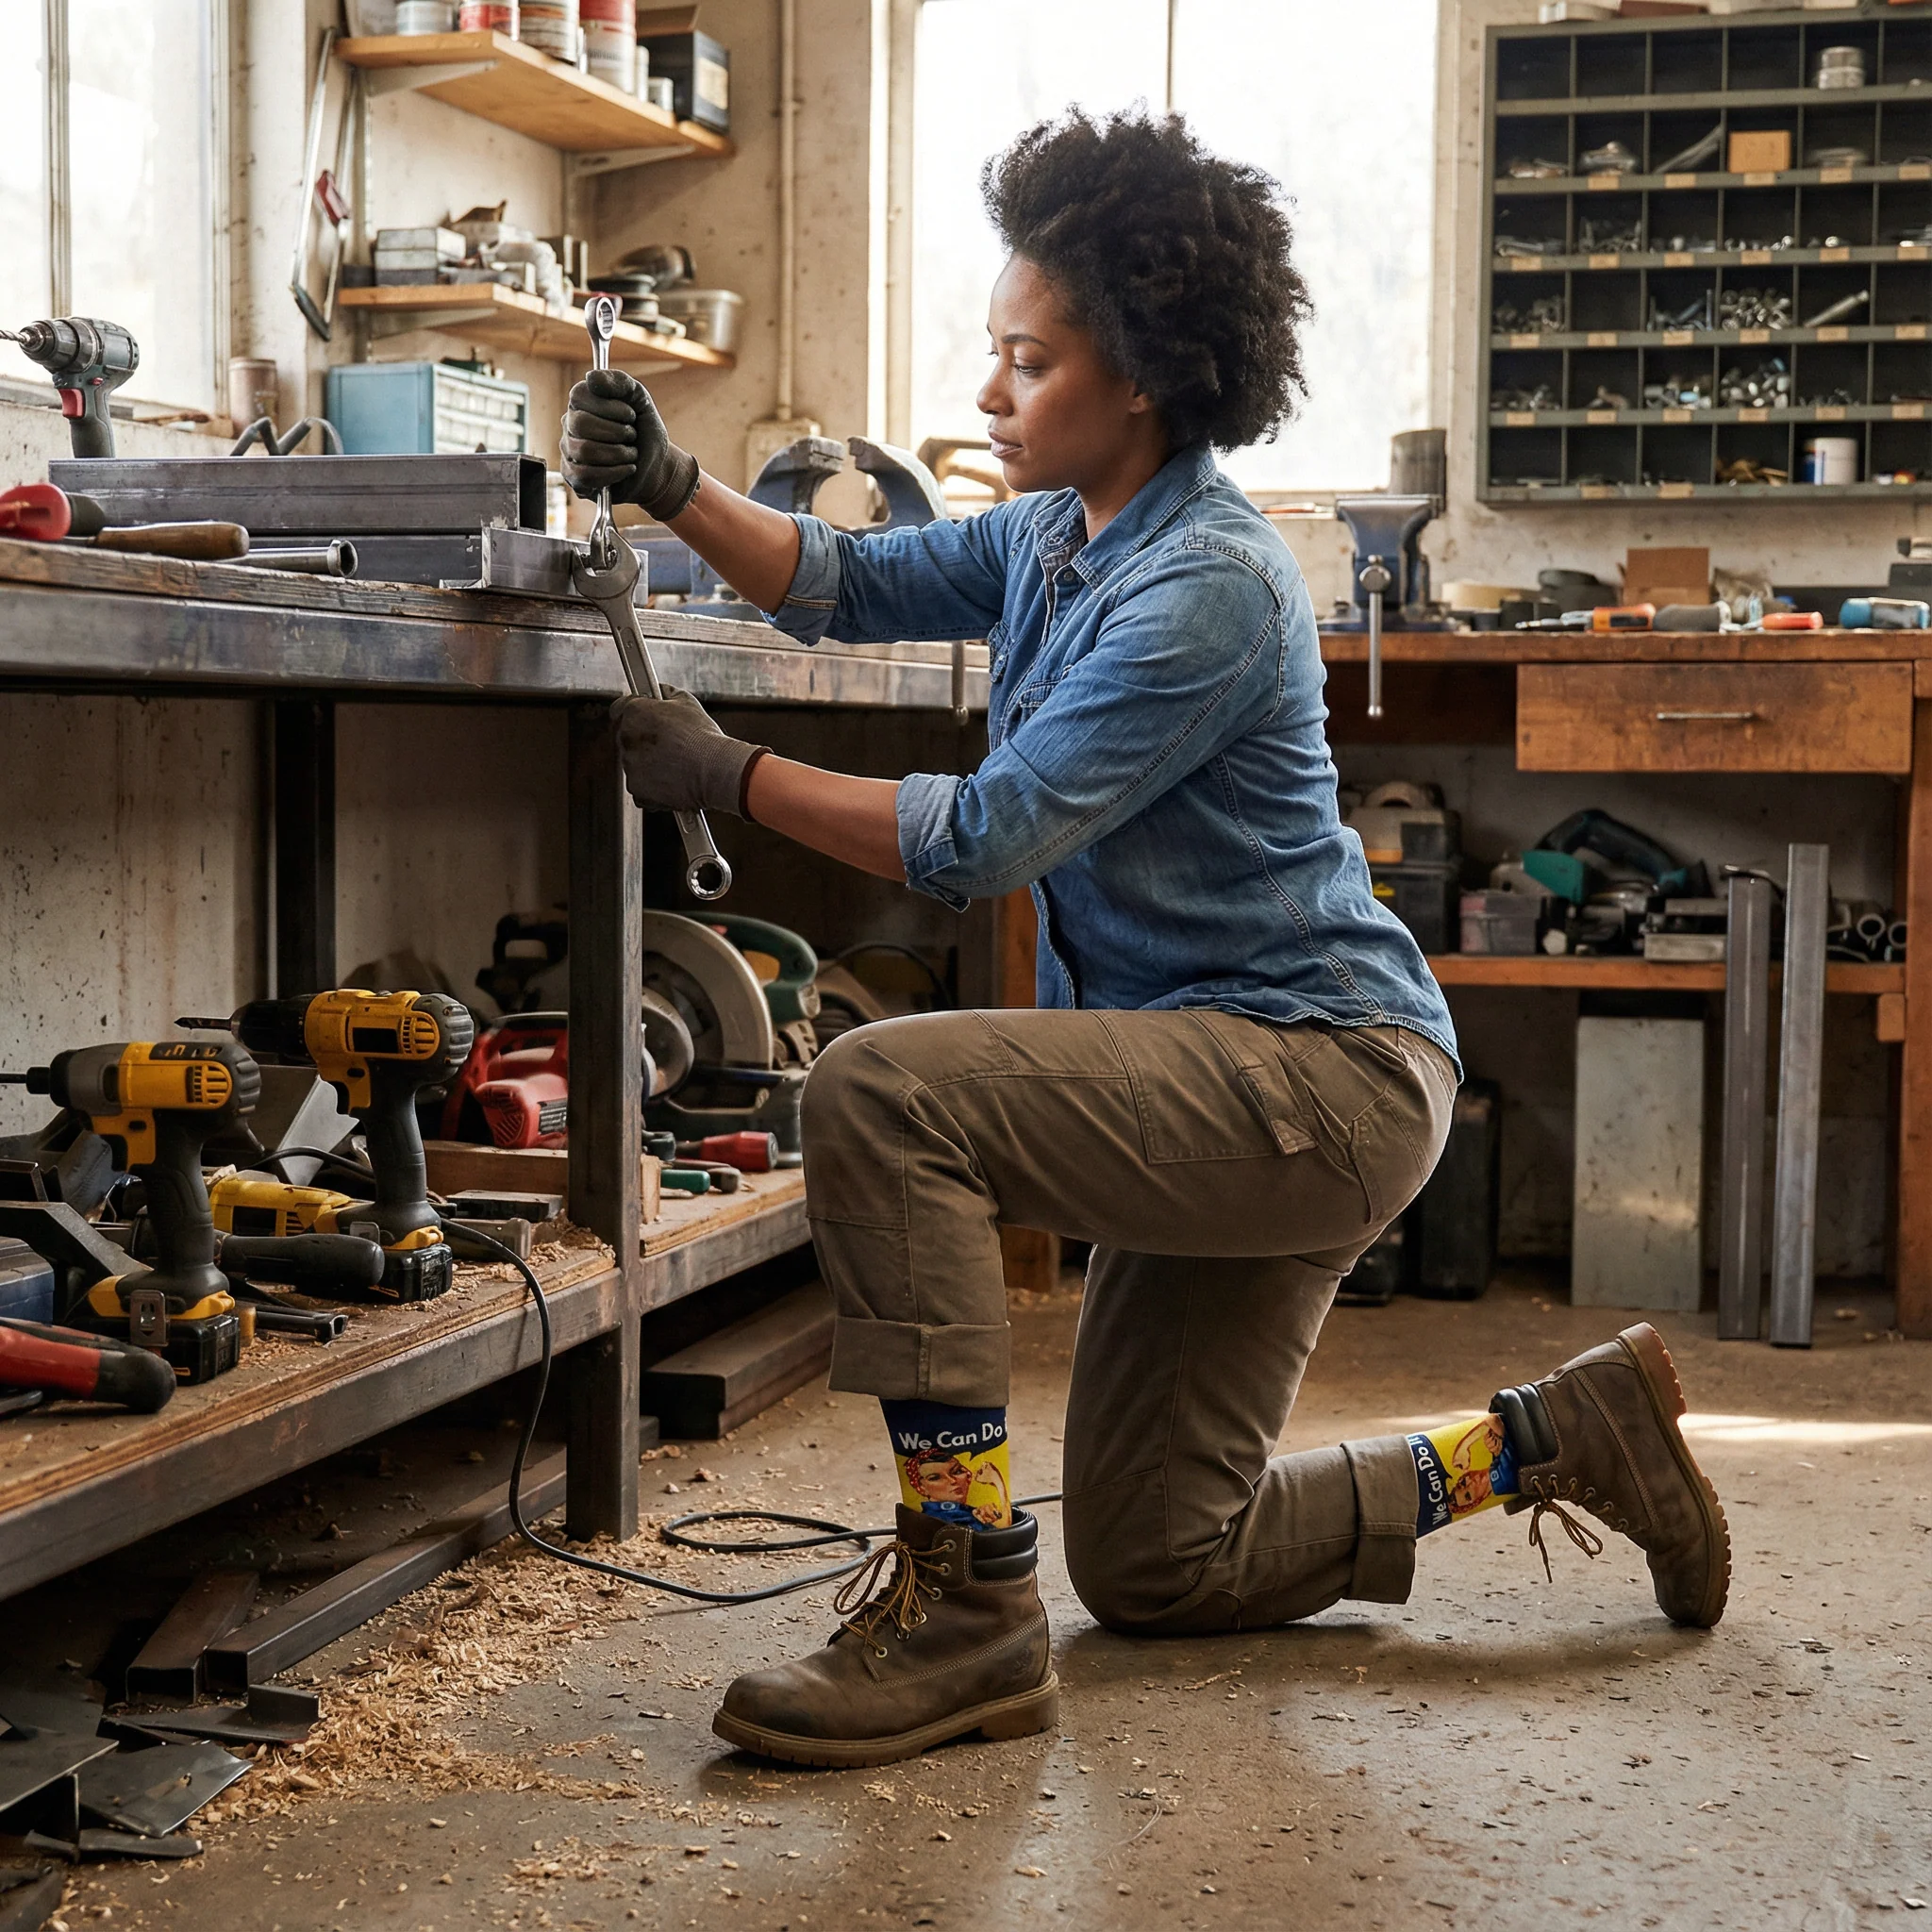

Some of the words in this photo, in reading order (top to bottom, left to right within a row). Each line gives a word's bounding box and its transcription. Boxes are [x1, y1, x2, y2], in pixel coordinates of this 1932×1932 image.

[898, 1432, 932, 1450] We
[937, 1431, 977, 1448] Can
[982, 1423, 1003, 1441] Do
[1418, 1447, 1435, 1471] Do
[1428, 1471, 1443, 1503] Can
[1432, 1503, 1448, 1525] We
